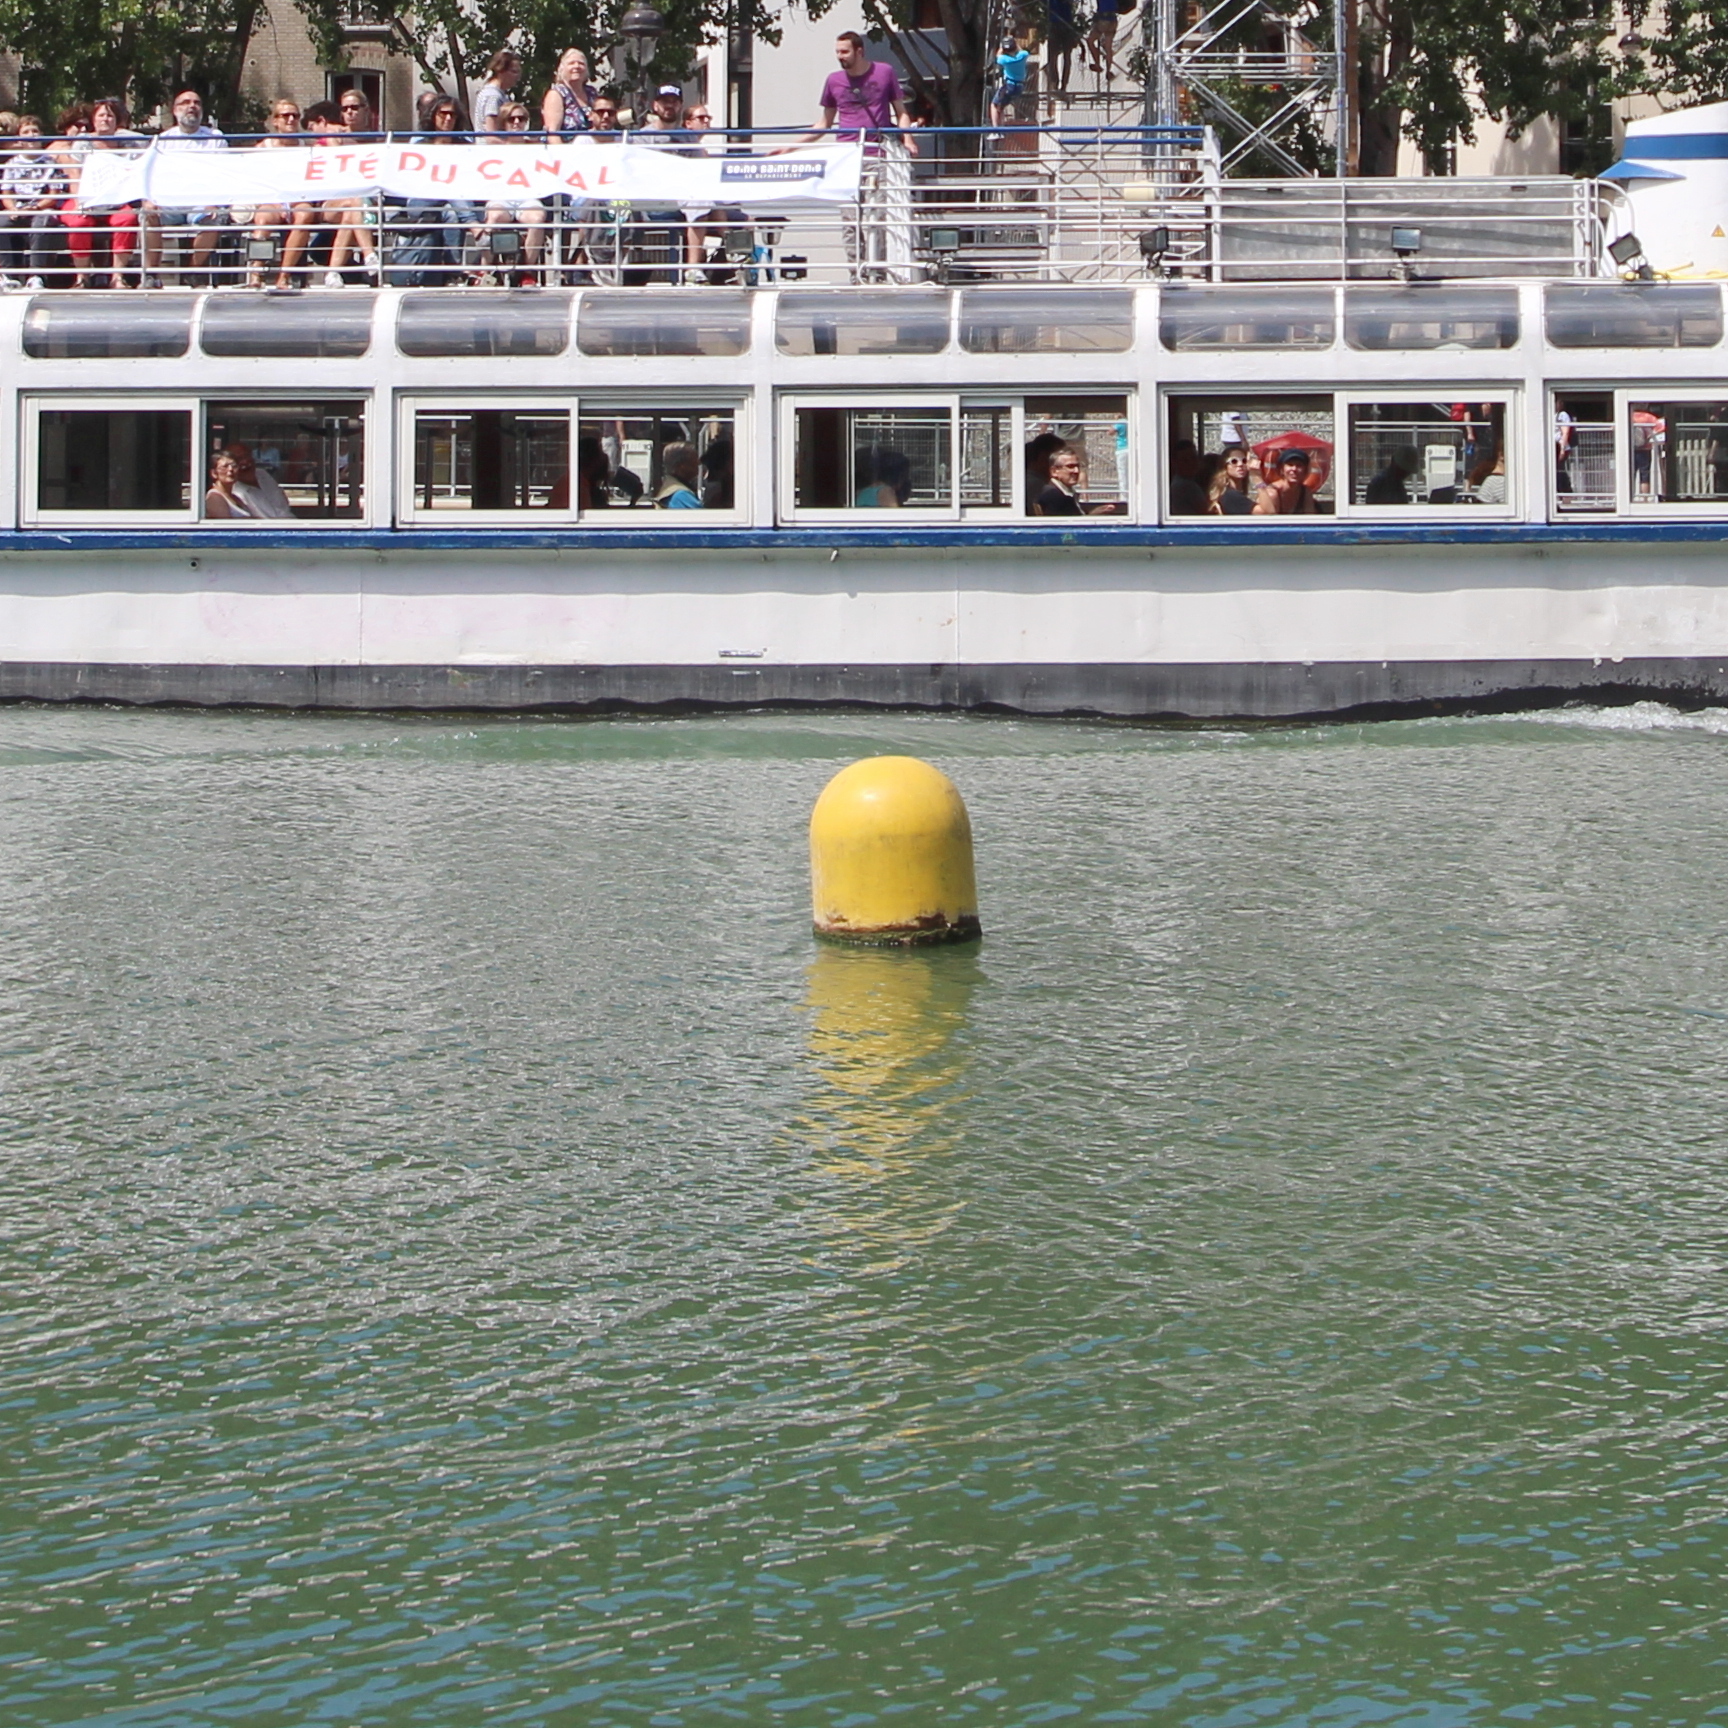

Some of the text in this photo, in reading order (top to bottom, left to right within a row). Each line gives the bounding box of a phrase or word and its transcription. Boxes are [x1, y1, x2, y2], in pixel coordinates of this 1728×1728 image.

[304, 151, 616, 191] ÉTÉ DU CANAL
